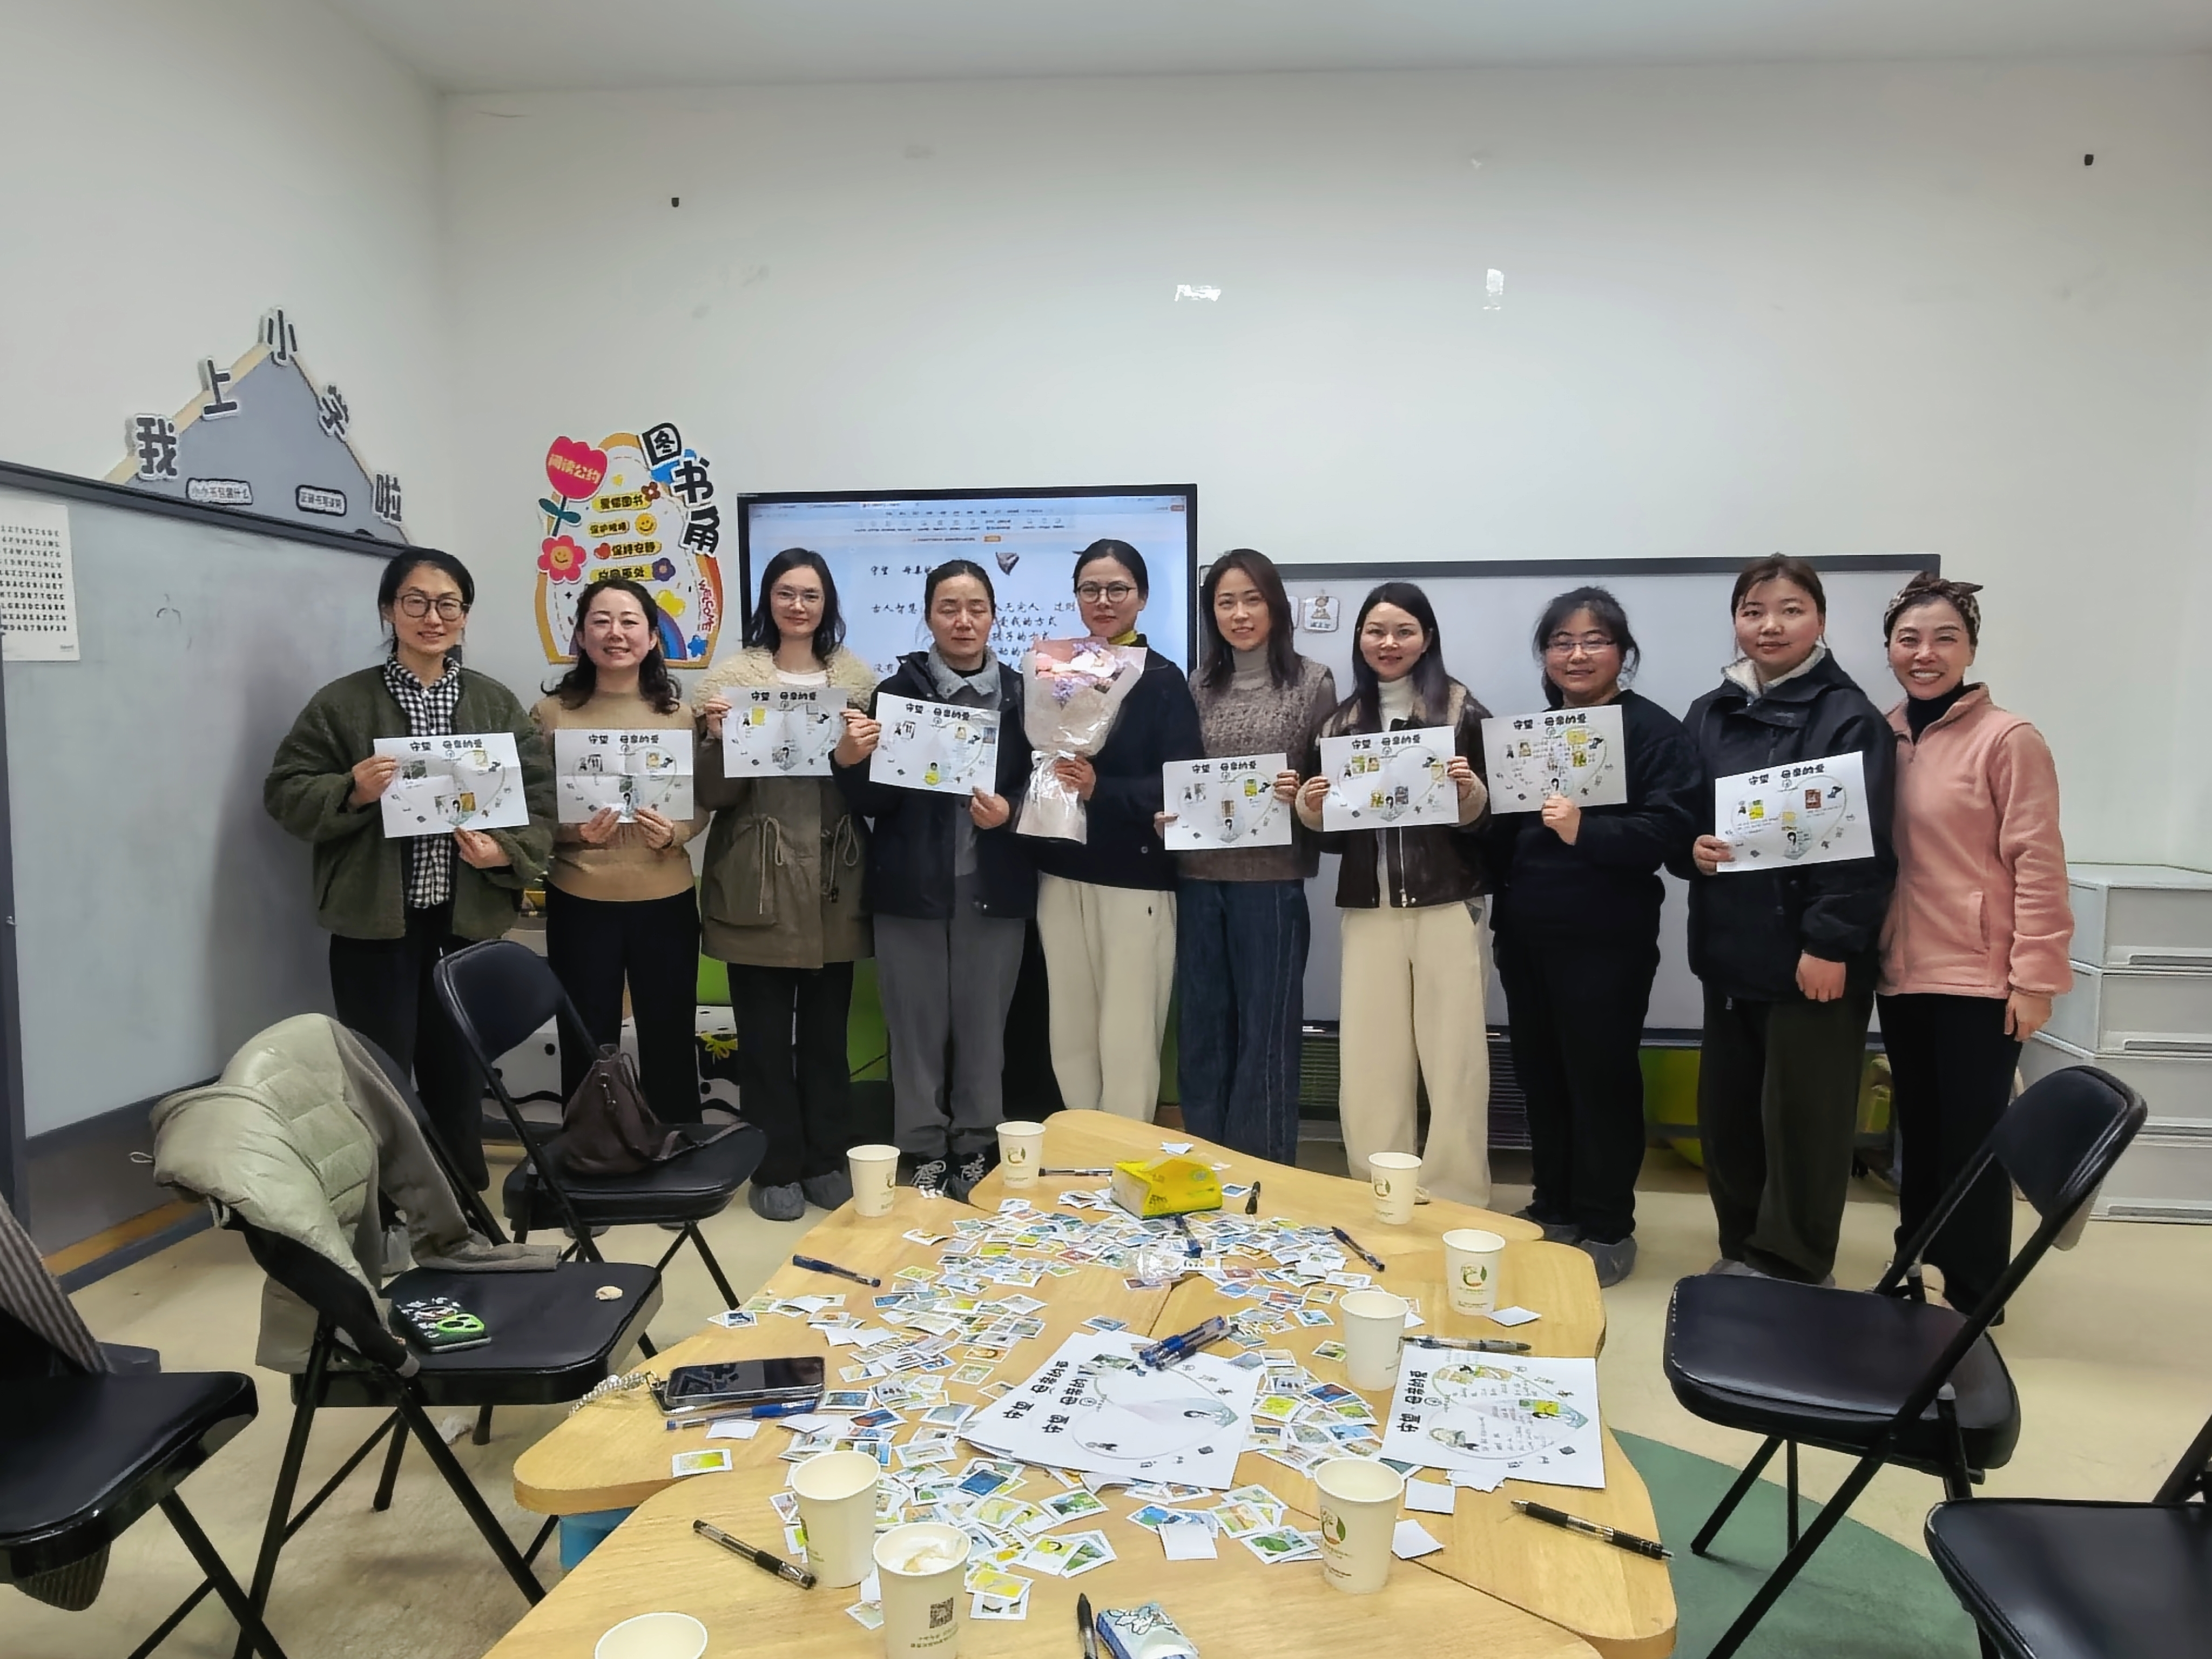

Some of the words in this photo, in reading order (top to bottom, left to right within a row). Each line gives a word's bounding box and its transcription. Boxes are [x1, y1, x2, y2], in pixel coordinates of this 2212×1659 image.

[548, 454, 601, 484] 阅读公约
[642, 422, 719, 555] 图书角
[612, 542, 655, 556] 保持安静
[698, 579, 714, 632] WELCOME
[1003, 1400, 1035, 1420] 守望
[1030, 1360, 1069, 1394] 母亲的爱
[1042, 1414, 1070, 1434] 守望
[1060, 1378, 1088, 1406] 母亲的
[1404, 1370, 1428, 1405] 母亲的爱
[1397, 1413, 1421, 1433] 守望
